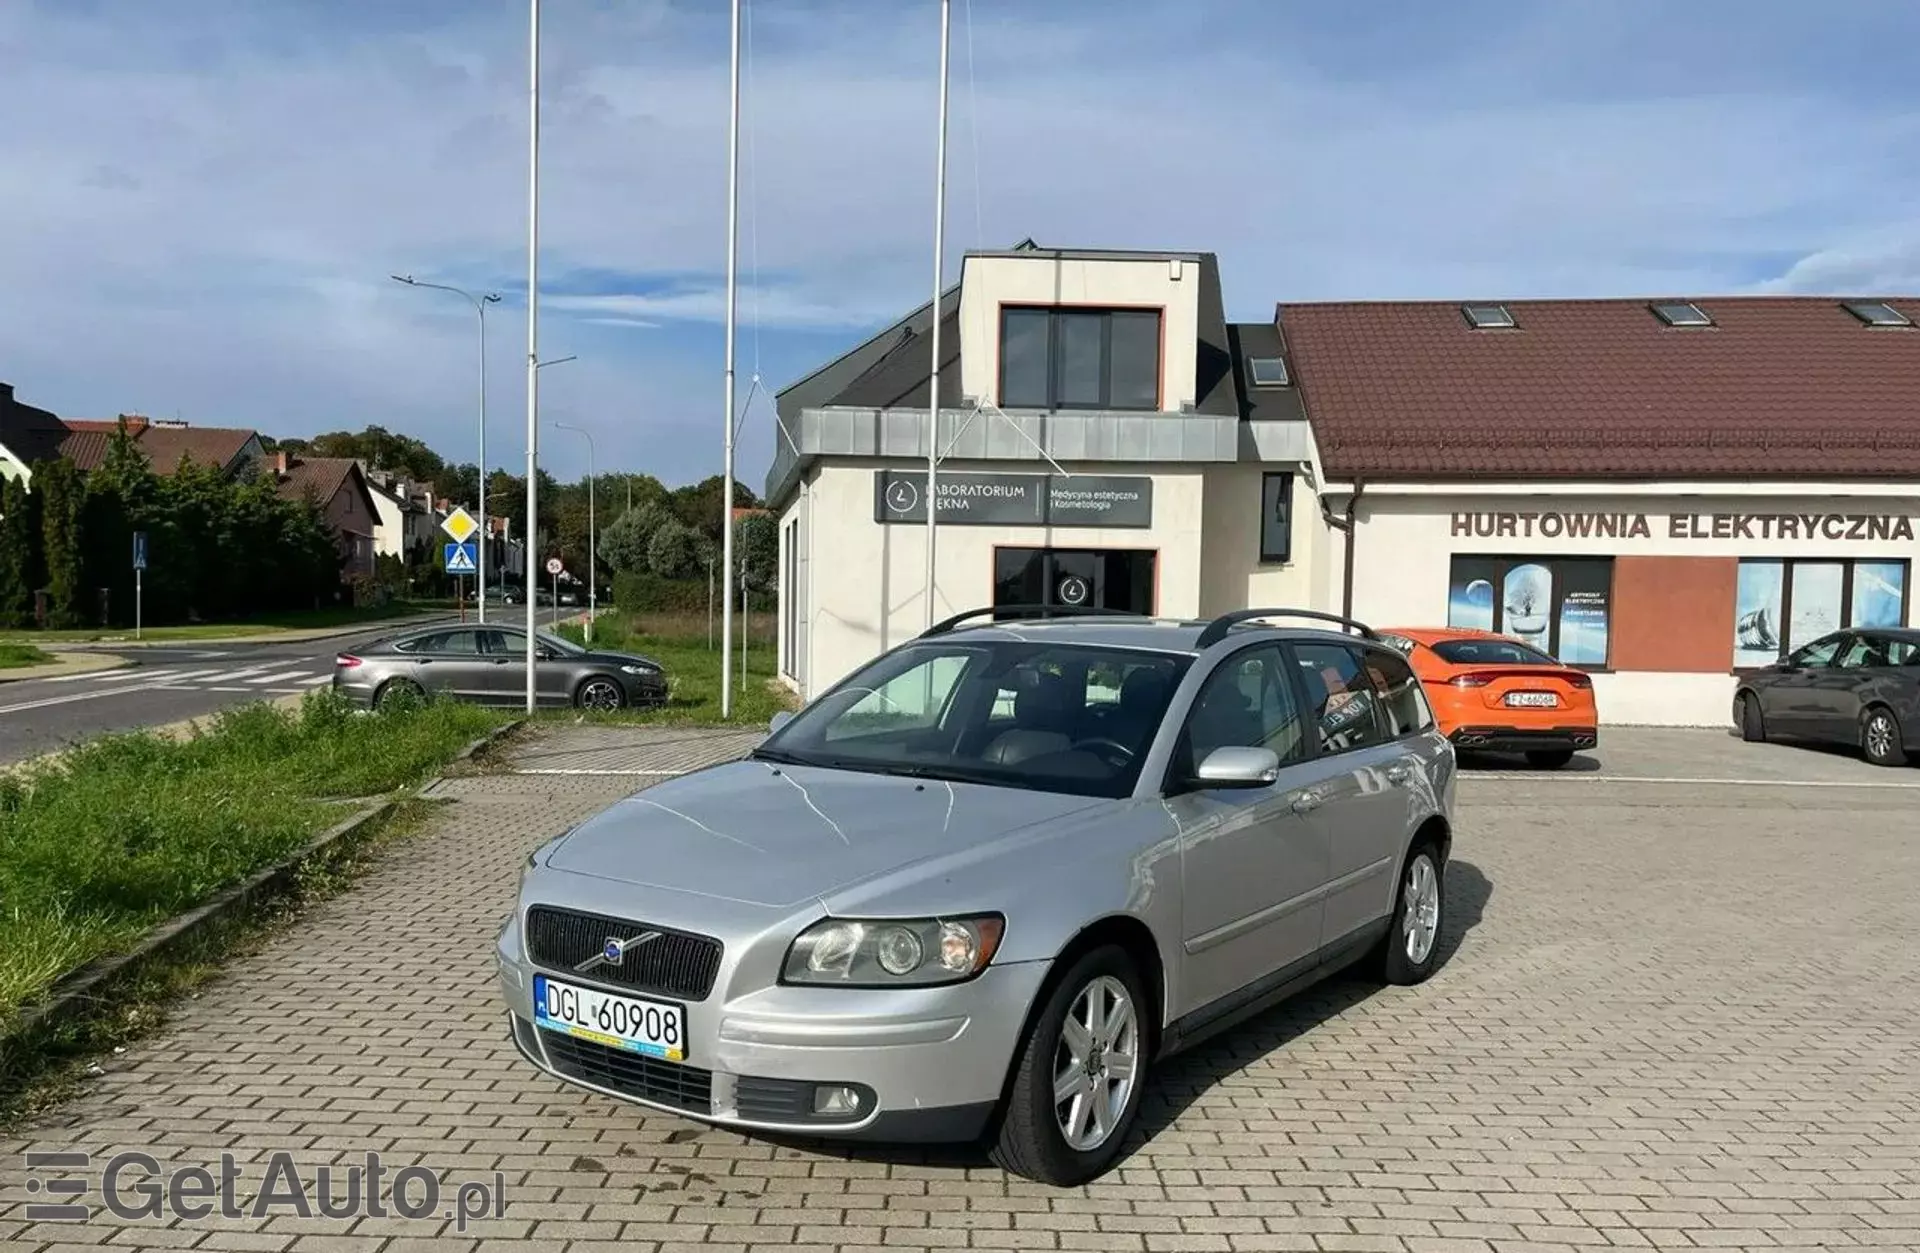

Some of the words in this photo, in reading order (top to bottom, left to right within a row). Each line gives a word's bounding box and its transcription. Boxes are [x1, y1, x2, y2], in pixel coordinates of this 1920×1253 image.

[926, 497, 970, 510] ĘKNA
[1051, 489, 1093, 501] Medycyna
[1093, 490, 1139, 502] estetyczna
[1450, 512, 1651, 538] HURTOWNIA
[1668, 513, 1915, 541] ELEKTRYCZNA
[548, 984, 589, 1027] DGL
[598, 998, 679, 1046] 60908
